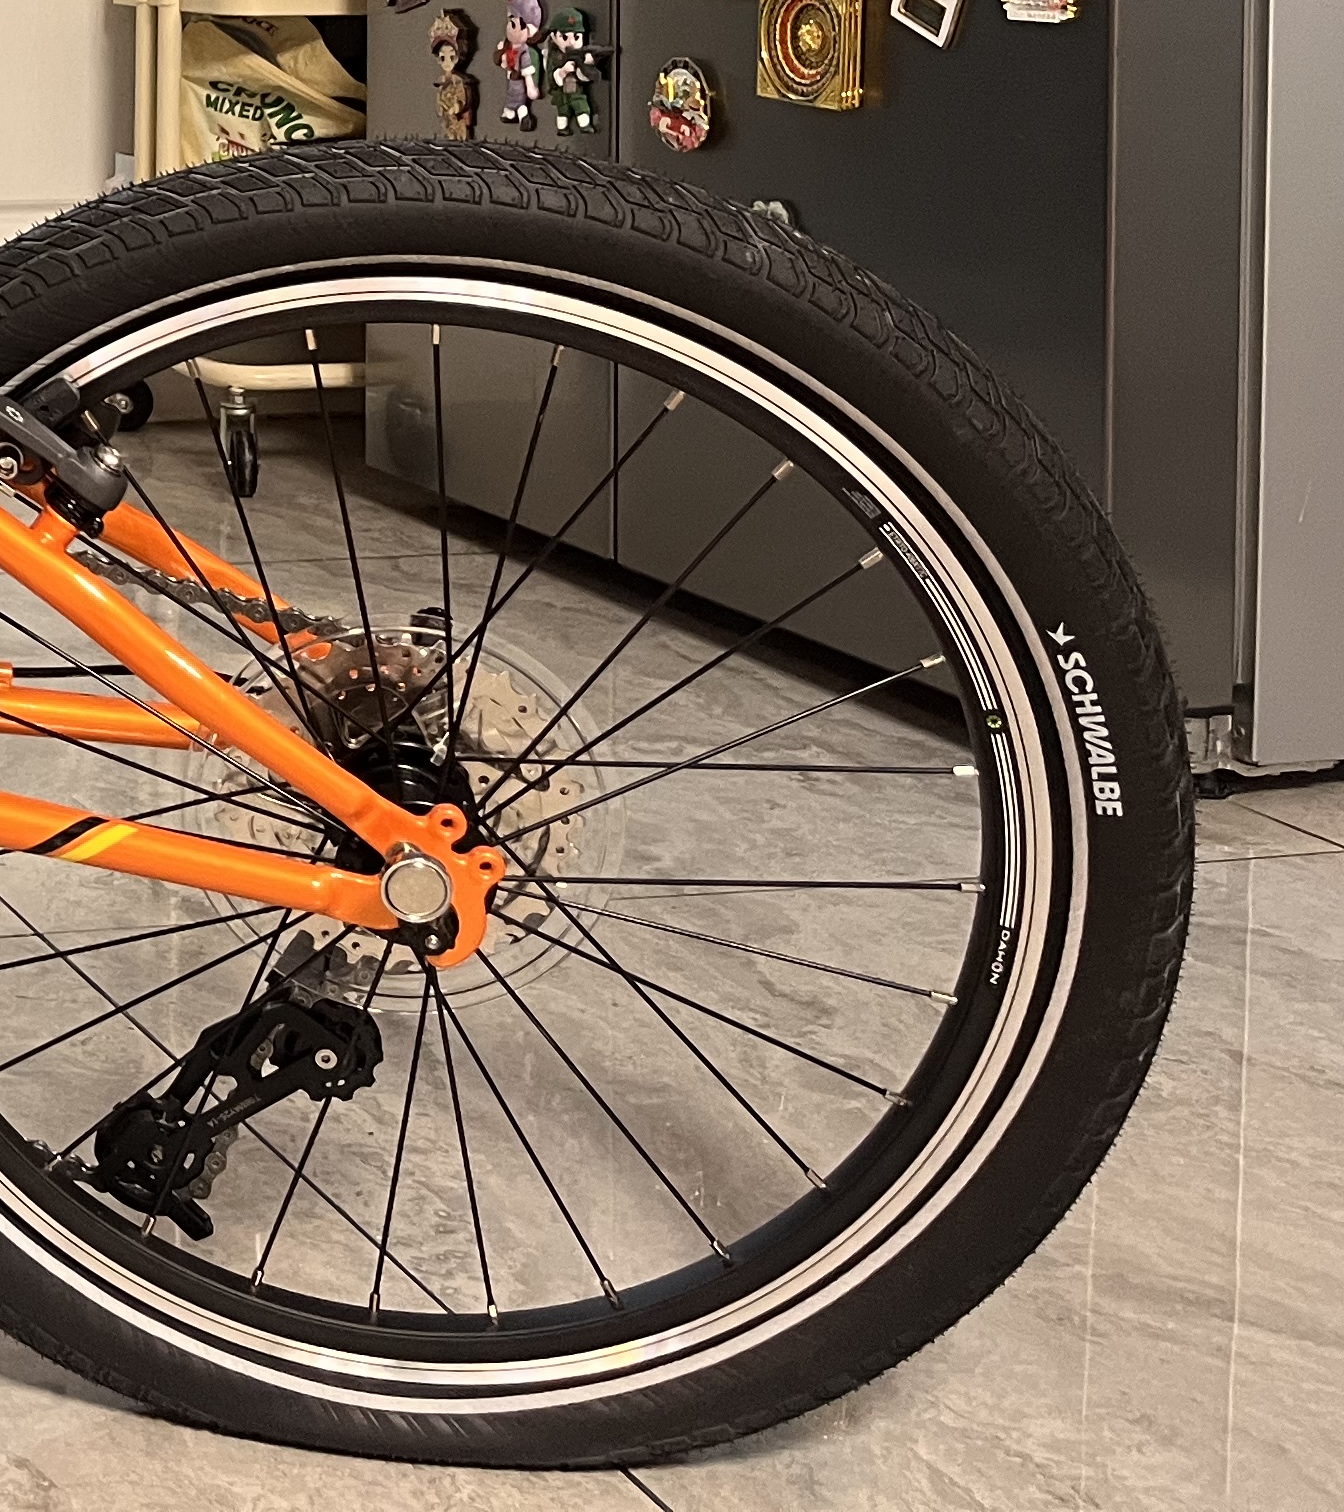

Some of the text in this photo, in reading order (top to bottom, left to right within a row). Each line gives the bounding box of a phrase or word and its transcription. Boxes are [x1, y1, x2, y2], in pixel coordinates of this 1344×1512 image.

[204, 92, 264, 122] MIXED
[1057, 650, 1124, 818] SCHWALBE
[989, 929, 1011, 986] DAHON
